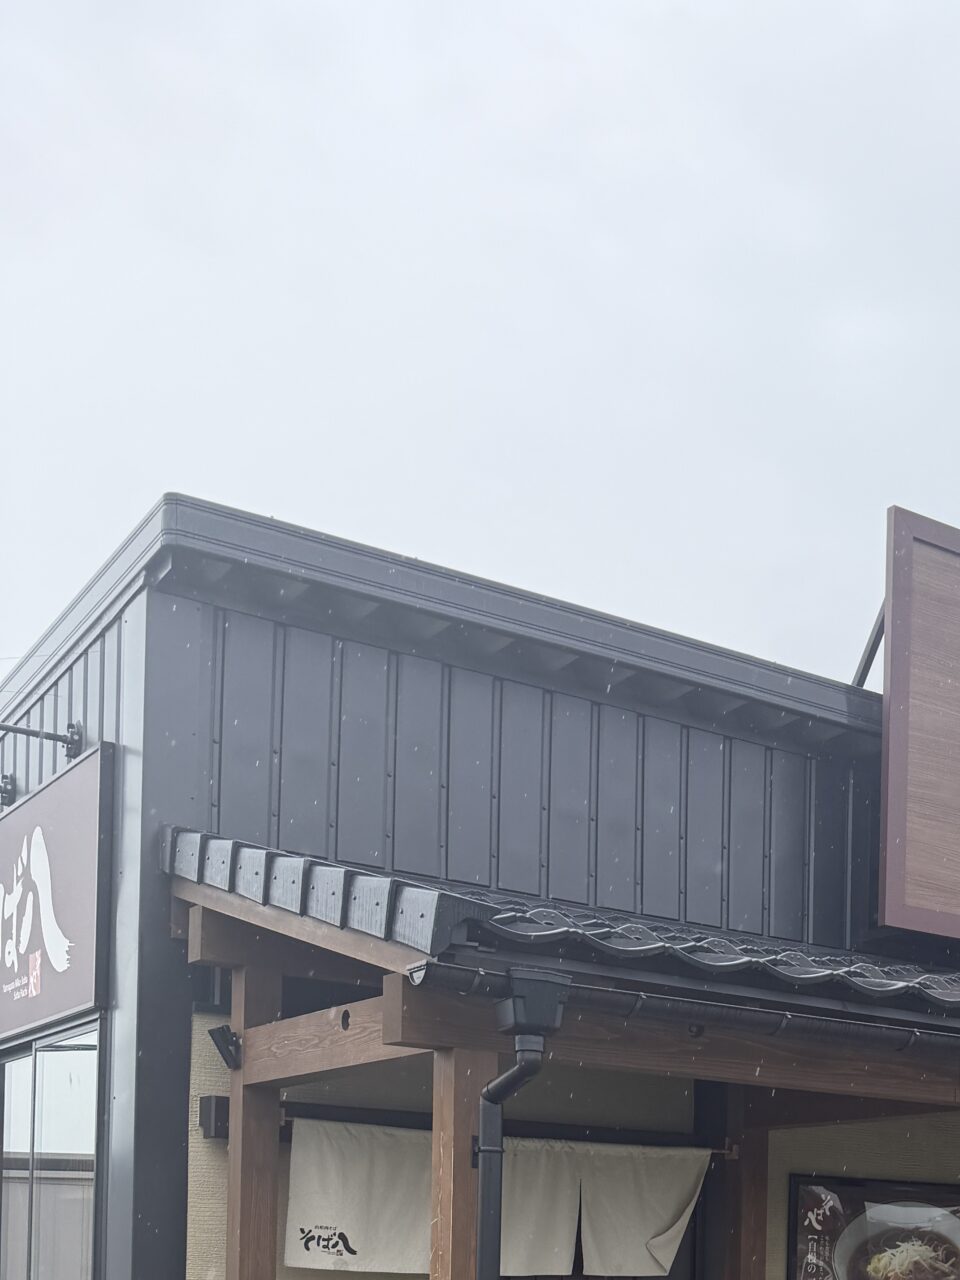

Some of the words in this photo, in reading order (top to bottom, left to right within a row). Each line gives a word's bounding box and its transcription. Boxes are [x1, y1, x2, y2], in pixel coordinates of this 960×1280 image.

[0, 826, 75, 973] ば八
[299, 1227, 357, 1255] そば八
